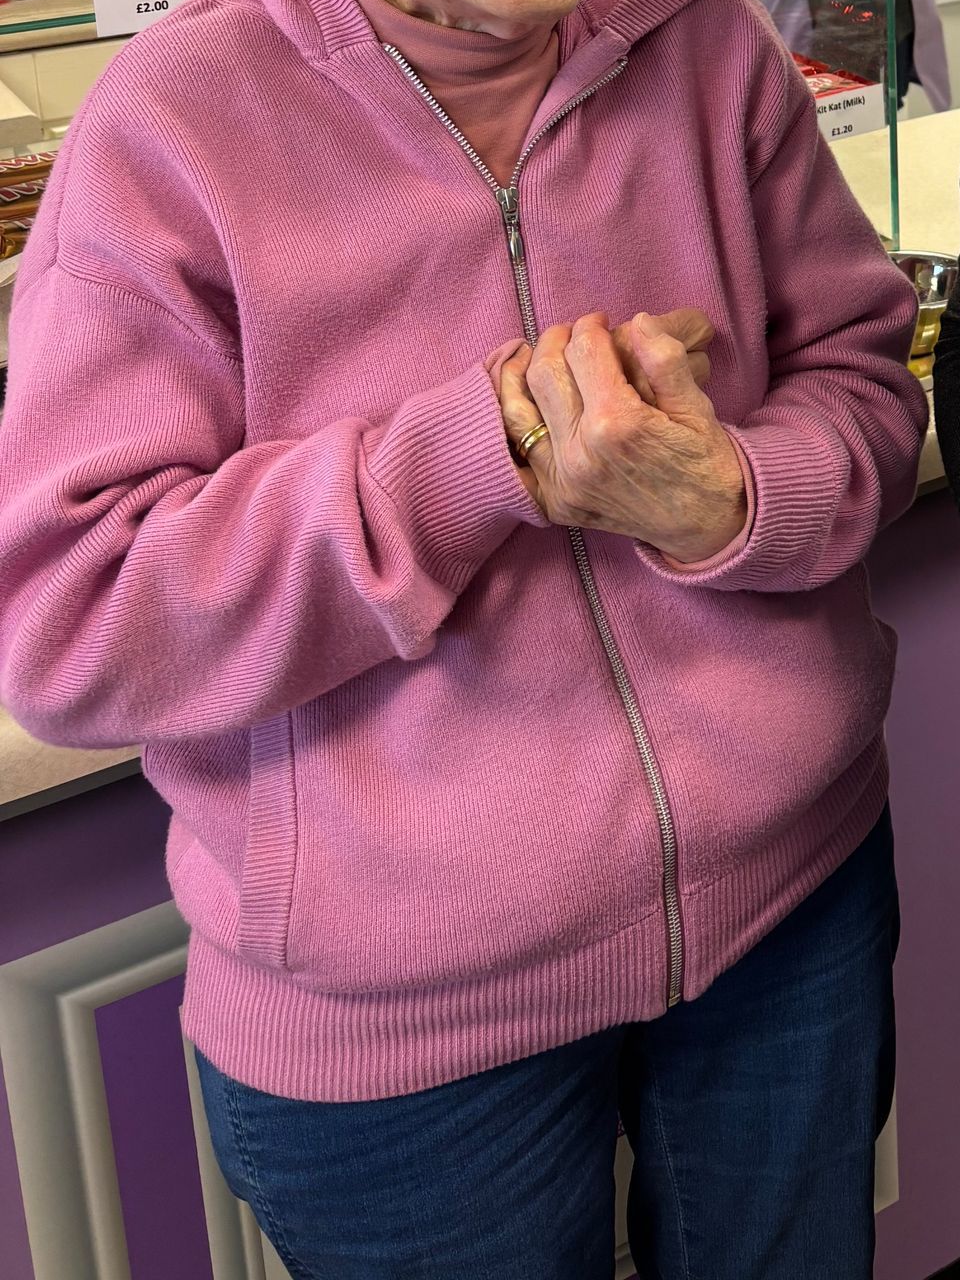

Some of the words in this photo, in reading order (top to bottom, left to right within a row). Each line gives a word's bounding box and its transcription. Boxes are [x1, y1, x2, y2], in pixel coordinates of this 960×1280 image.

[136, 0, 169, 13] £2.00
[817, 104, 827, 114] Kit
[828, 102, 842, 111] Kat
[843, 95, 866, 110] (Milk)
[831, 124, 853, 137] £1.20
